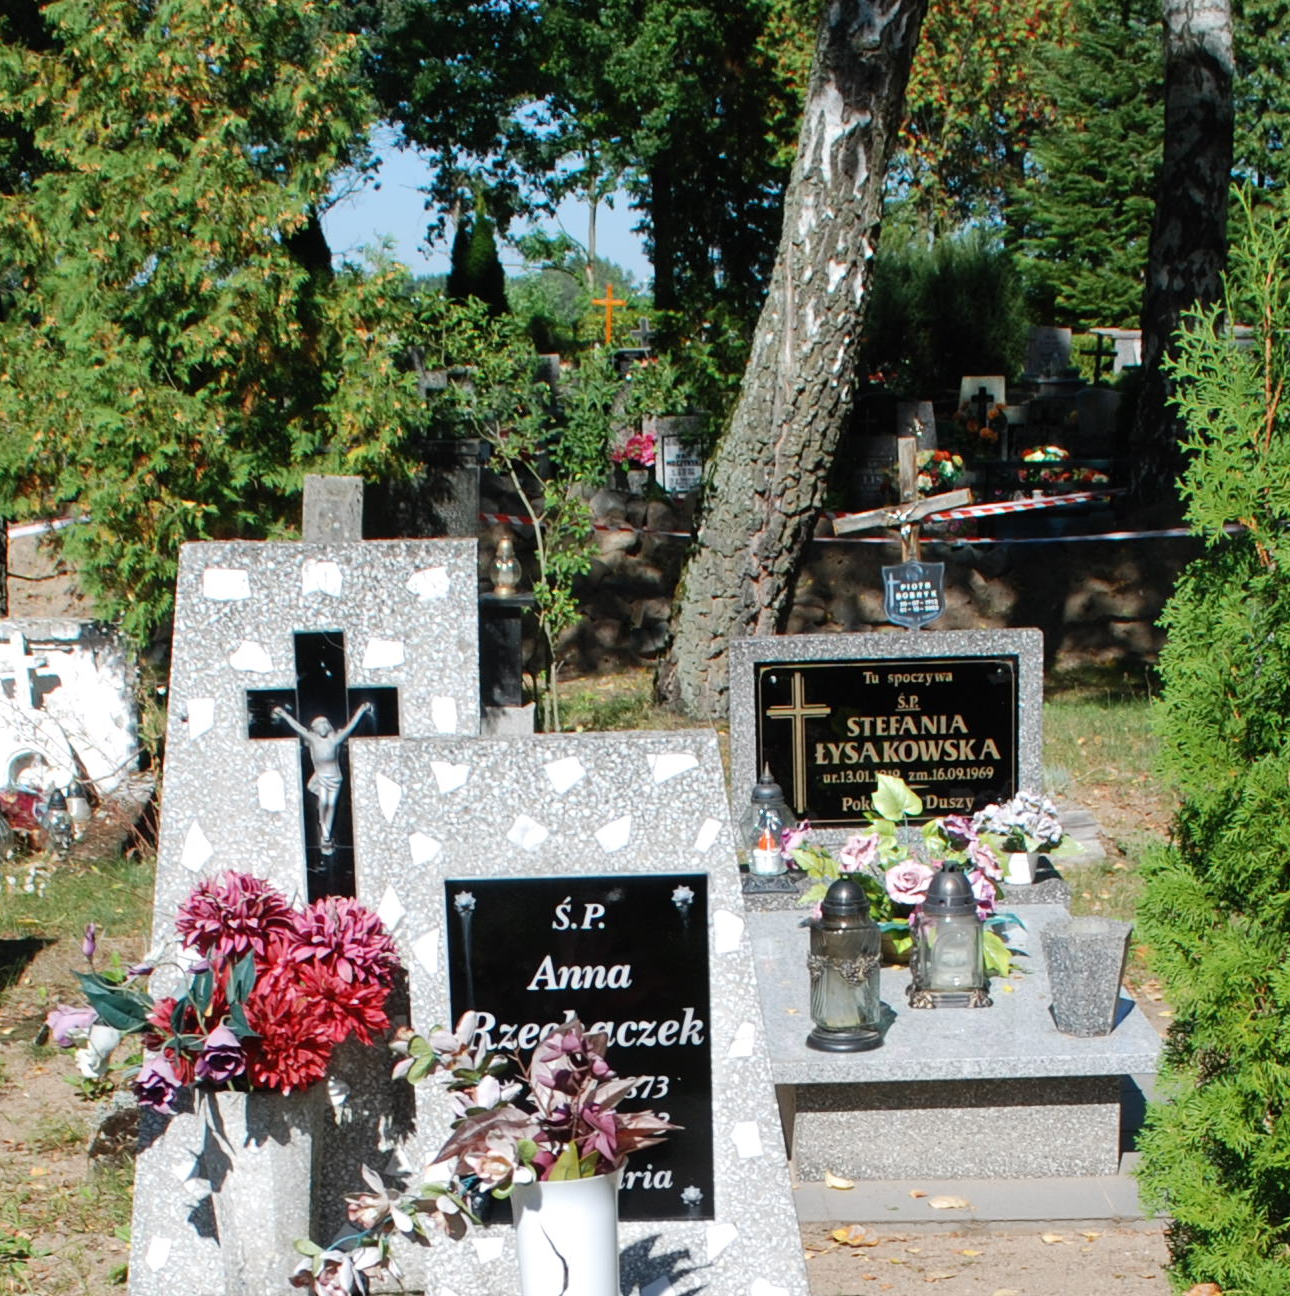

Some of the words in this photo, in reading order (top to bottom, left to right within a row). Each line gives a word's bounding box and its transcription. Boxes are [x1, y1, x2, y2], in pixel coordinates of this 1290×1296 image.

[863, 671, 879, 684] Tu
[887, 671, 953, 687] spoczywa
[846, 714, 968, 737] STEFANIA
[815, 738, 1001, 765] ŁYSAKOWSKA
[925, 794, 975, 812] Duszy
[527, 955, 632, 991] Anna
